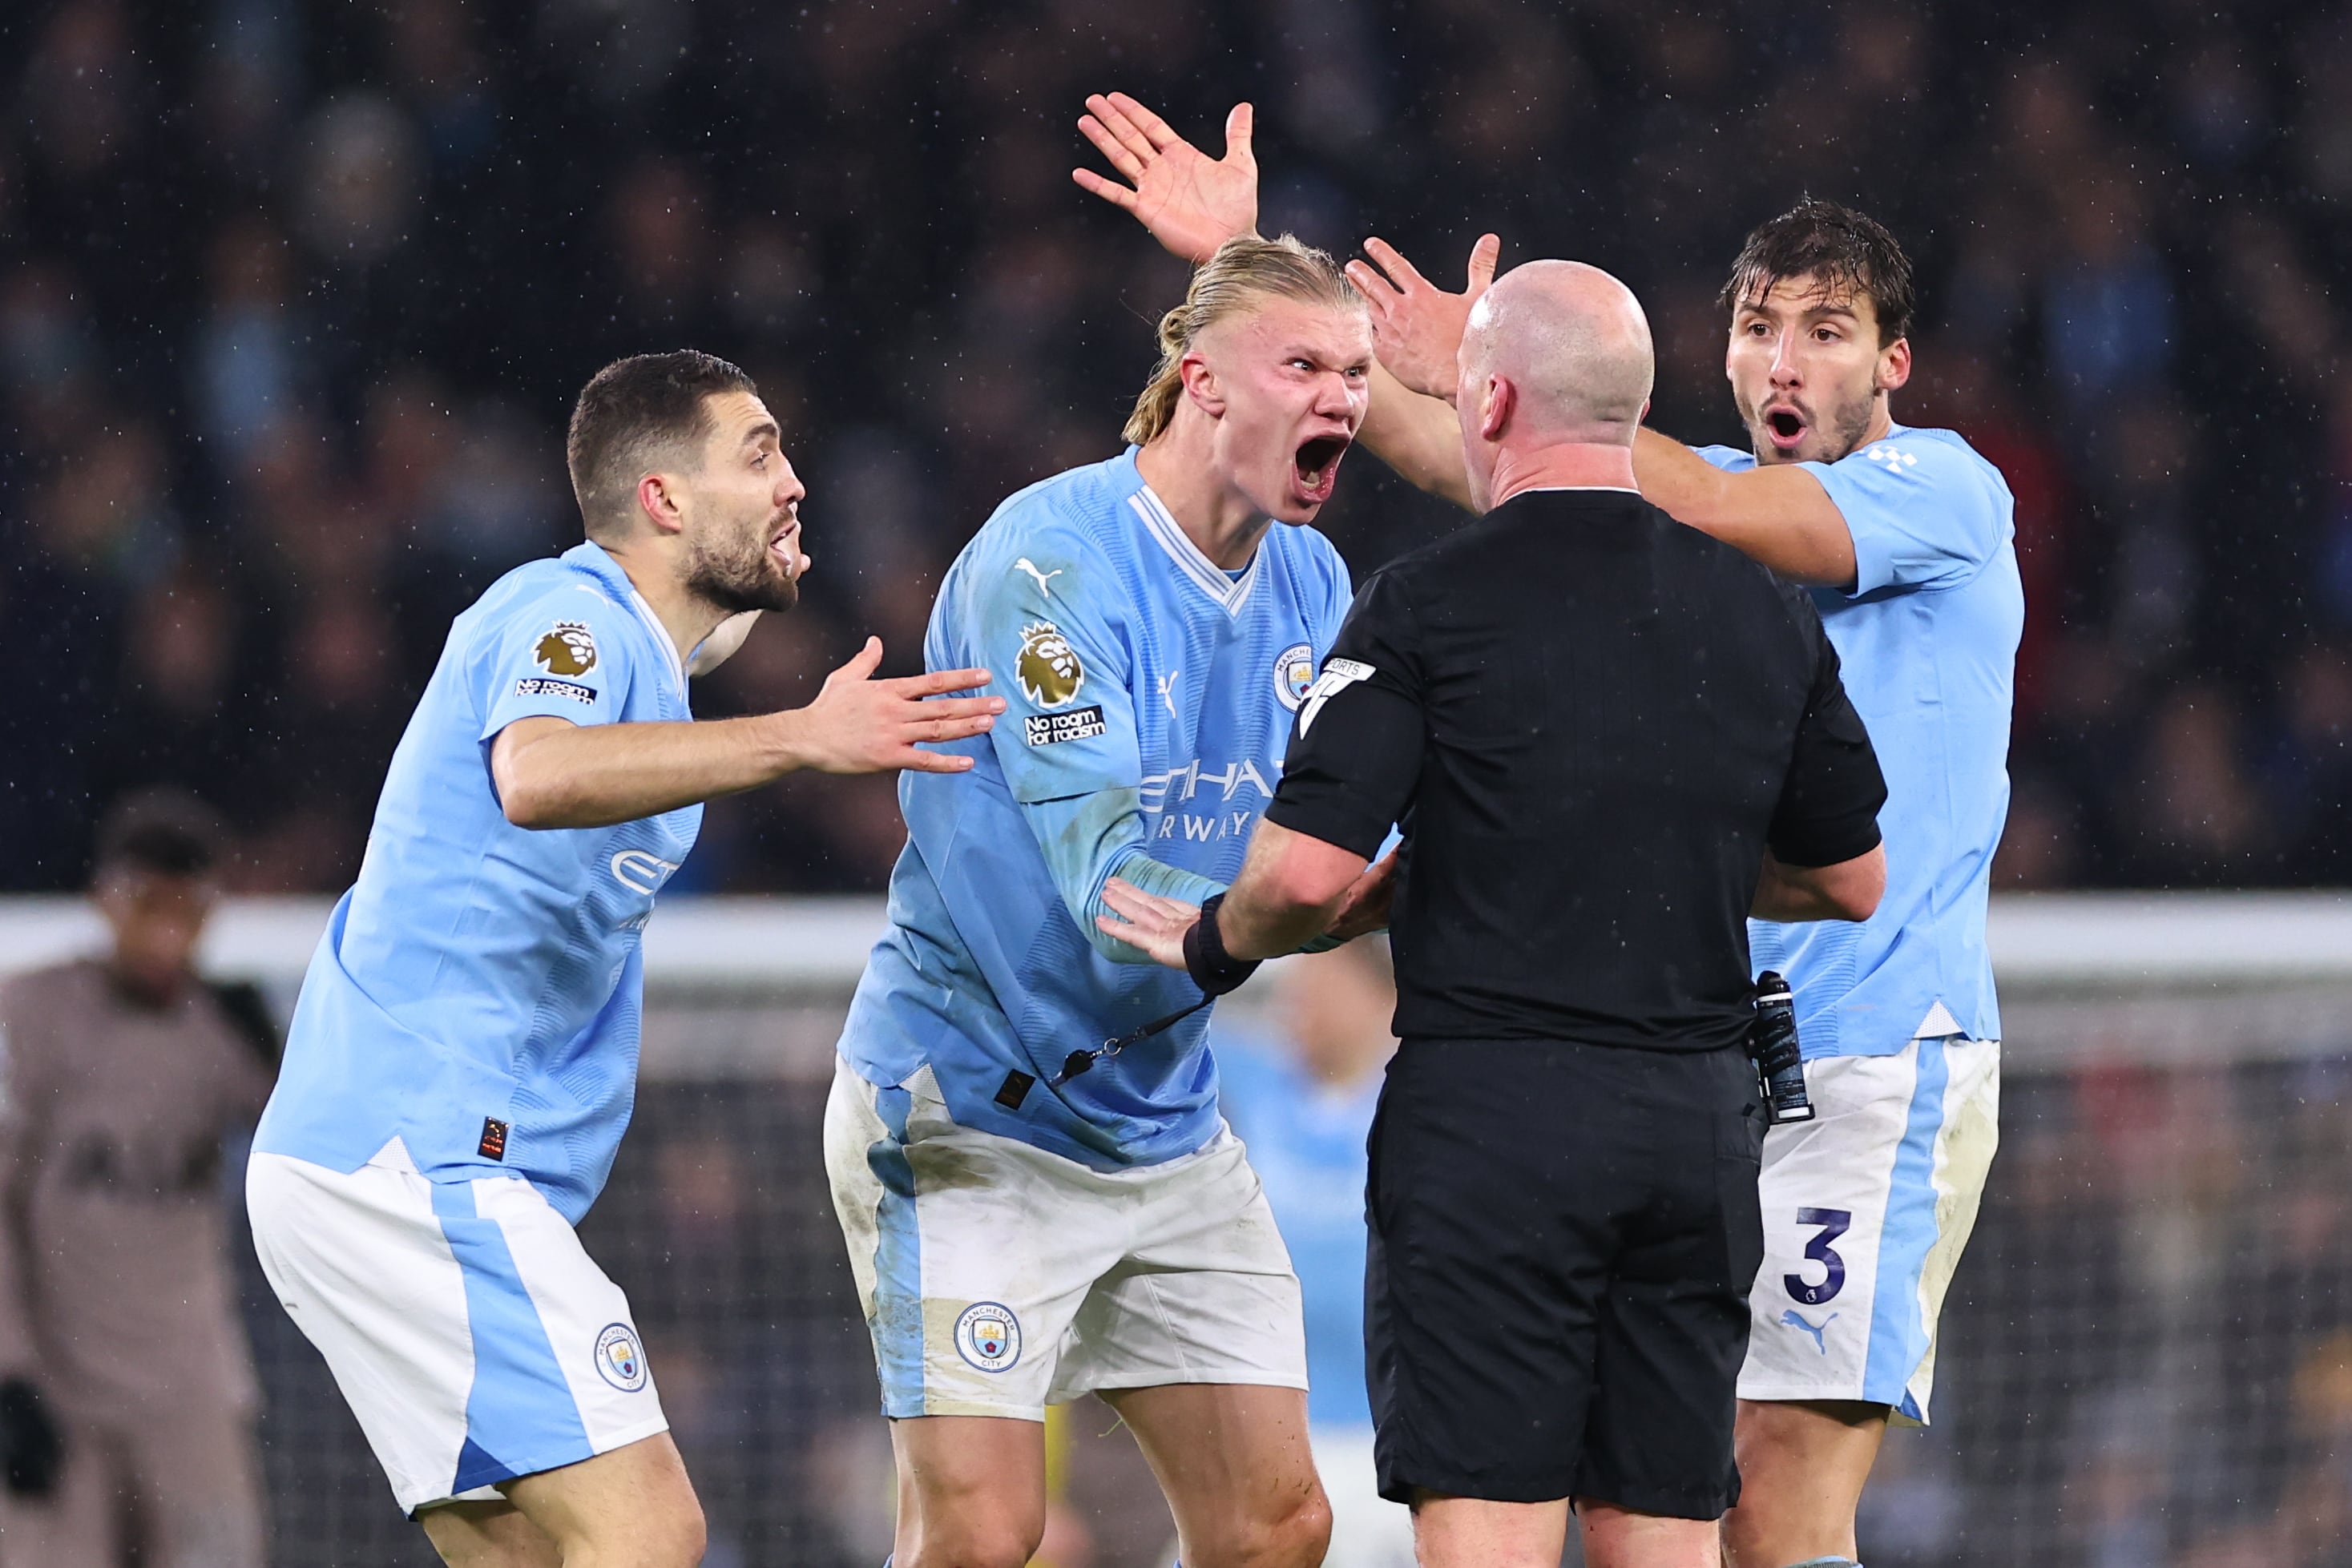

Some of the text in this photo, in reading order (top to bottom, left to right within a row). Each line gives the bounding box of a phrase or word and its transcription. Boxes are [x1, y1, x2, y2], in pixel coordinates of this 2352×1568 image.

[1277, 649, 1309, 671] MANCHE
[514, 687, 594, 705] for racism
[516, 679, 589, 696] No room
[1024, 711, 1096, 732] No room
[1027, 722, 1106, 746] for racism
[1140, 758, 1284, 813] ETIHA
[1152, 812, 1251, 842] RWAY
[1784, 1207, 1851, 1305] 3
[962, 1308, 1015, 1331] MANCHESTER
[599, 1328, 635, 1355] MANCHESTER
[627, 1379, 640, 1388] CITY
